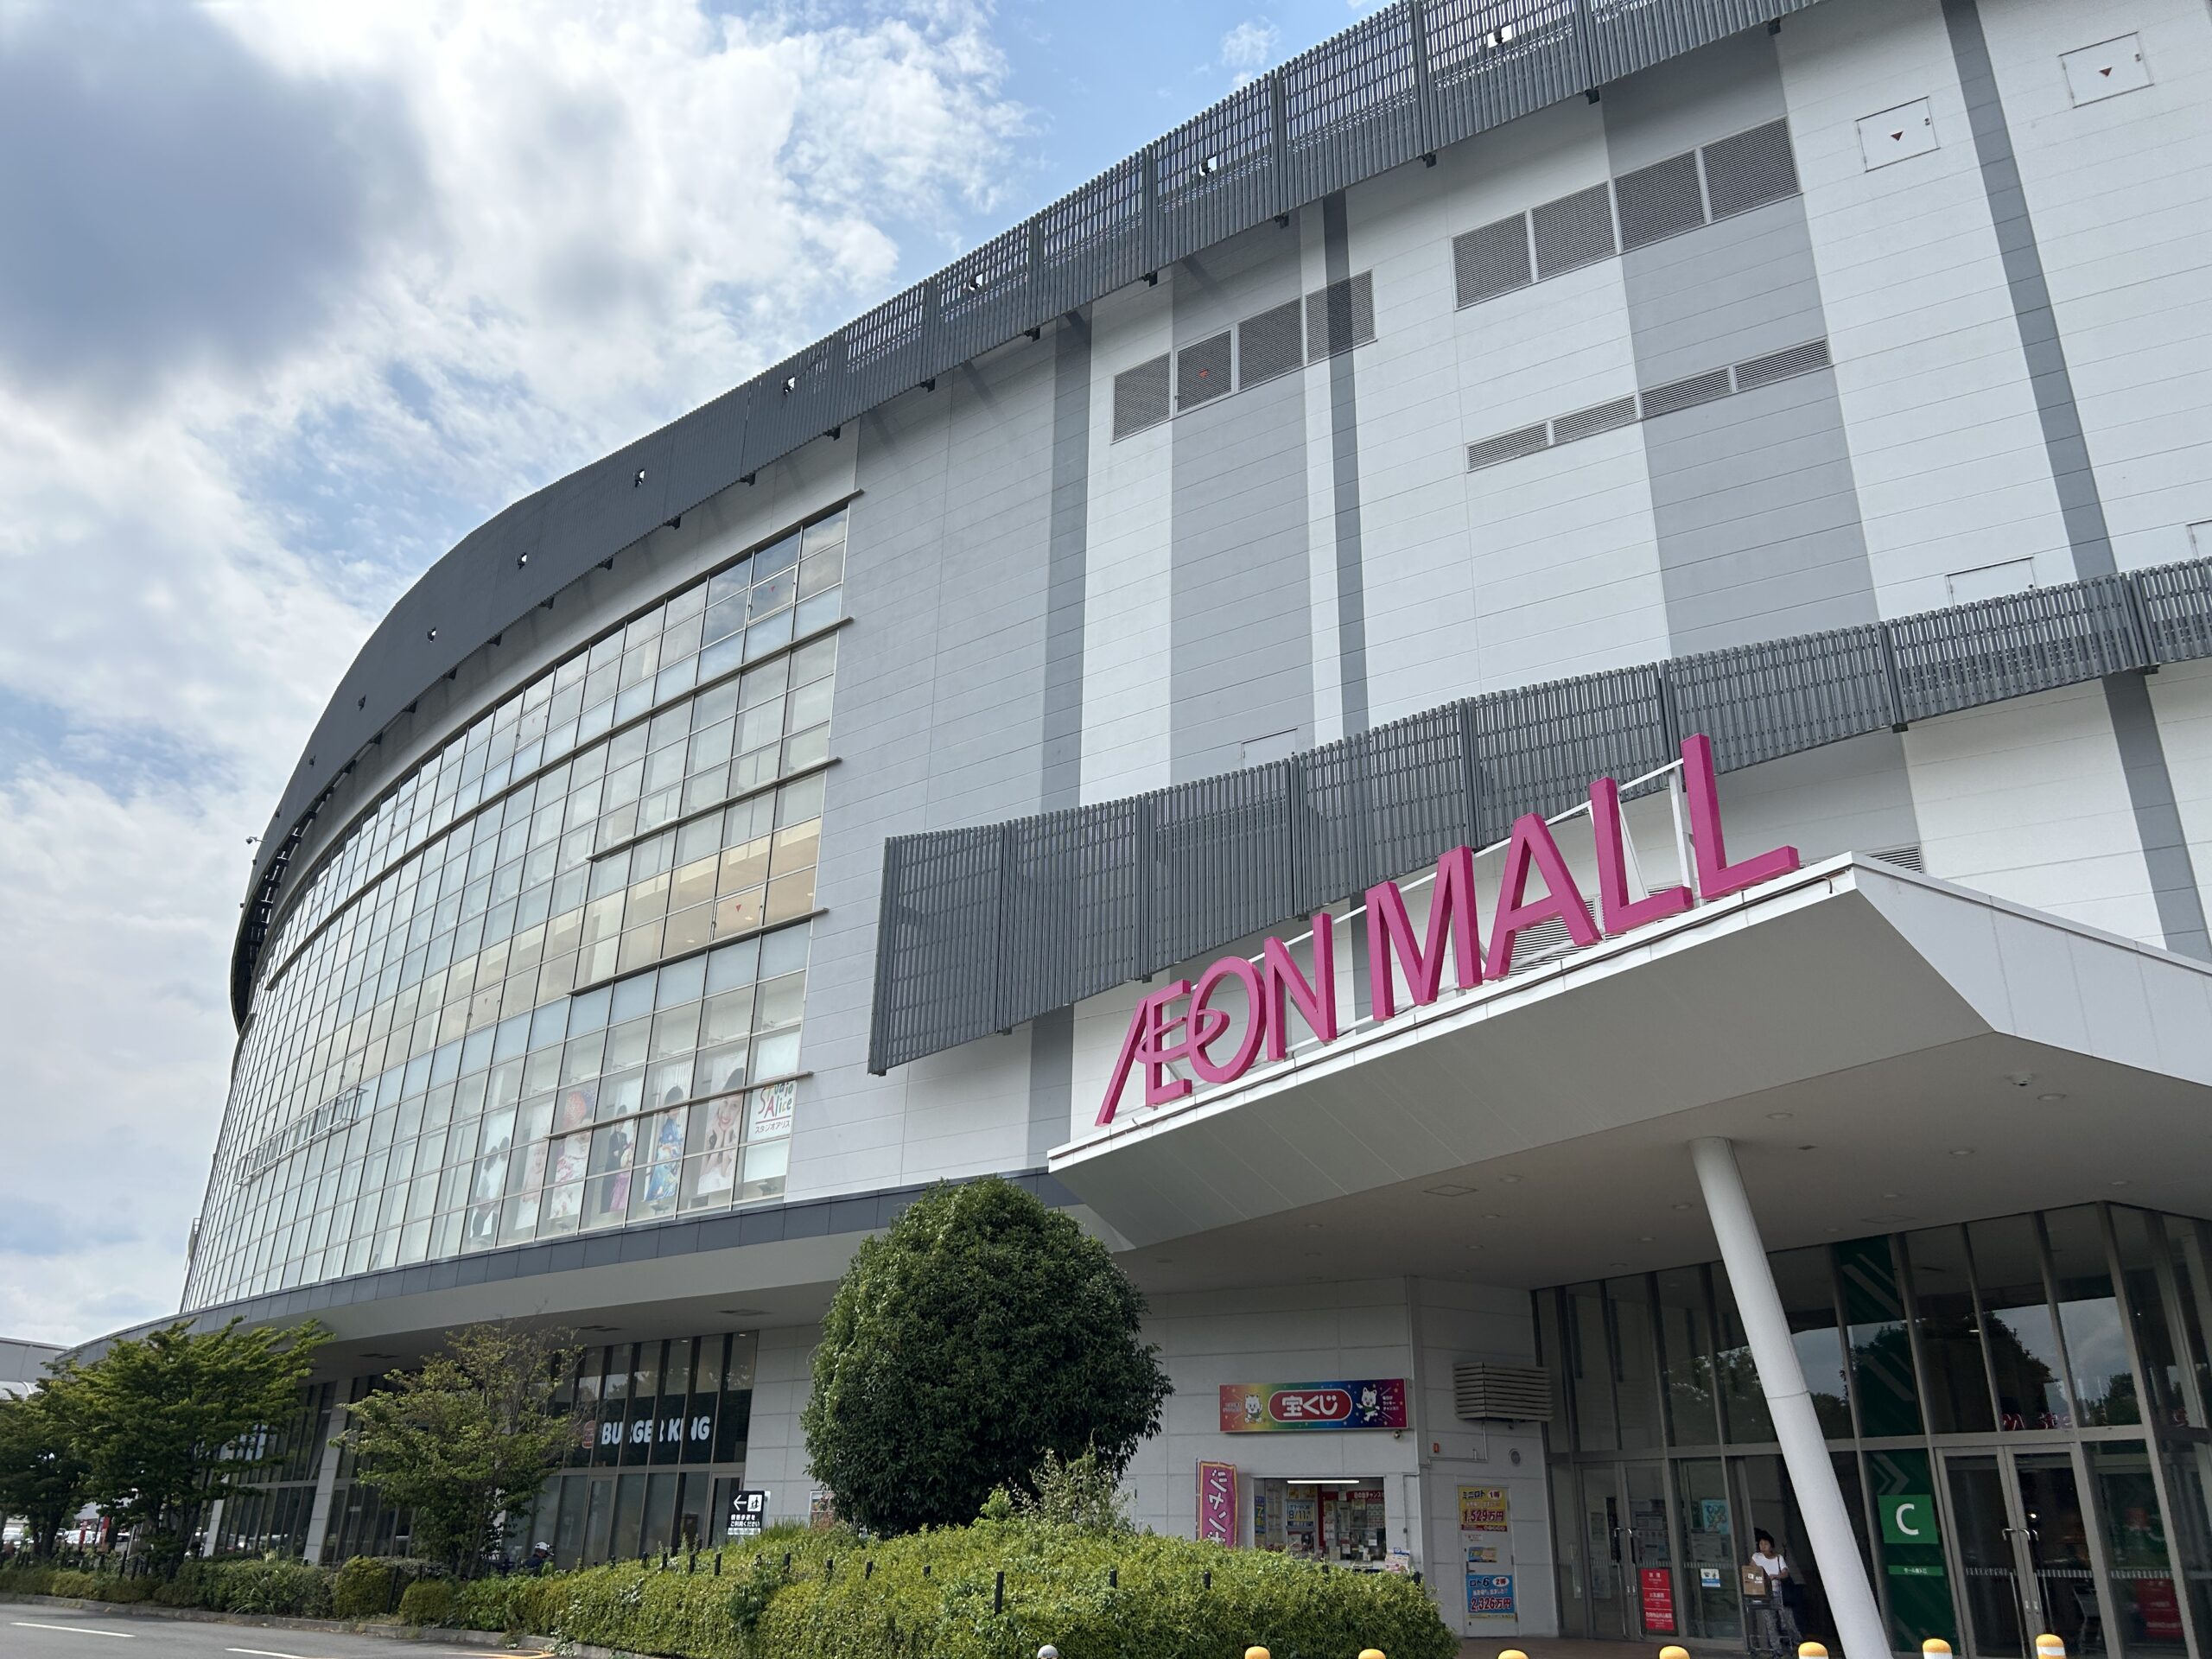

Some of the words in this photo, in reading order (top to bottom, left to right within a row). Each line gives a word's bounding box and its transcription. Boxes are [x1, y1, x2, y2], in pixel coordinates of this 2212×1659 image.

[1365, 733, 1800, 1021] MALL
[764, 1095, 792, 1119] Alice
[755, 1120, 791, 1134] スタジオアリス
[1281, 1395, 1338, 1417] 宝くじ
[601, 1420, 664, 1445] BUGE
[1462, 1490, 1485, 1499] ミニロト
[1464, 1509, 1504, 1522] 1,529万円
[1896, 1503, 1920, 1535] C
[1470, 1577, 1491, 1586] ロト6
[1471, 1596, 1511, 1611] 2,326万円
